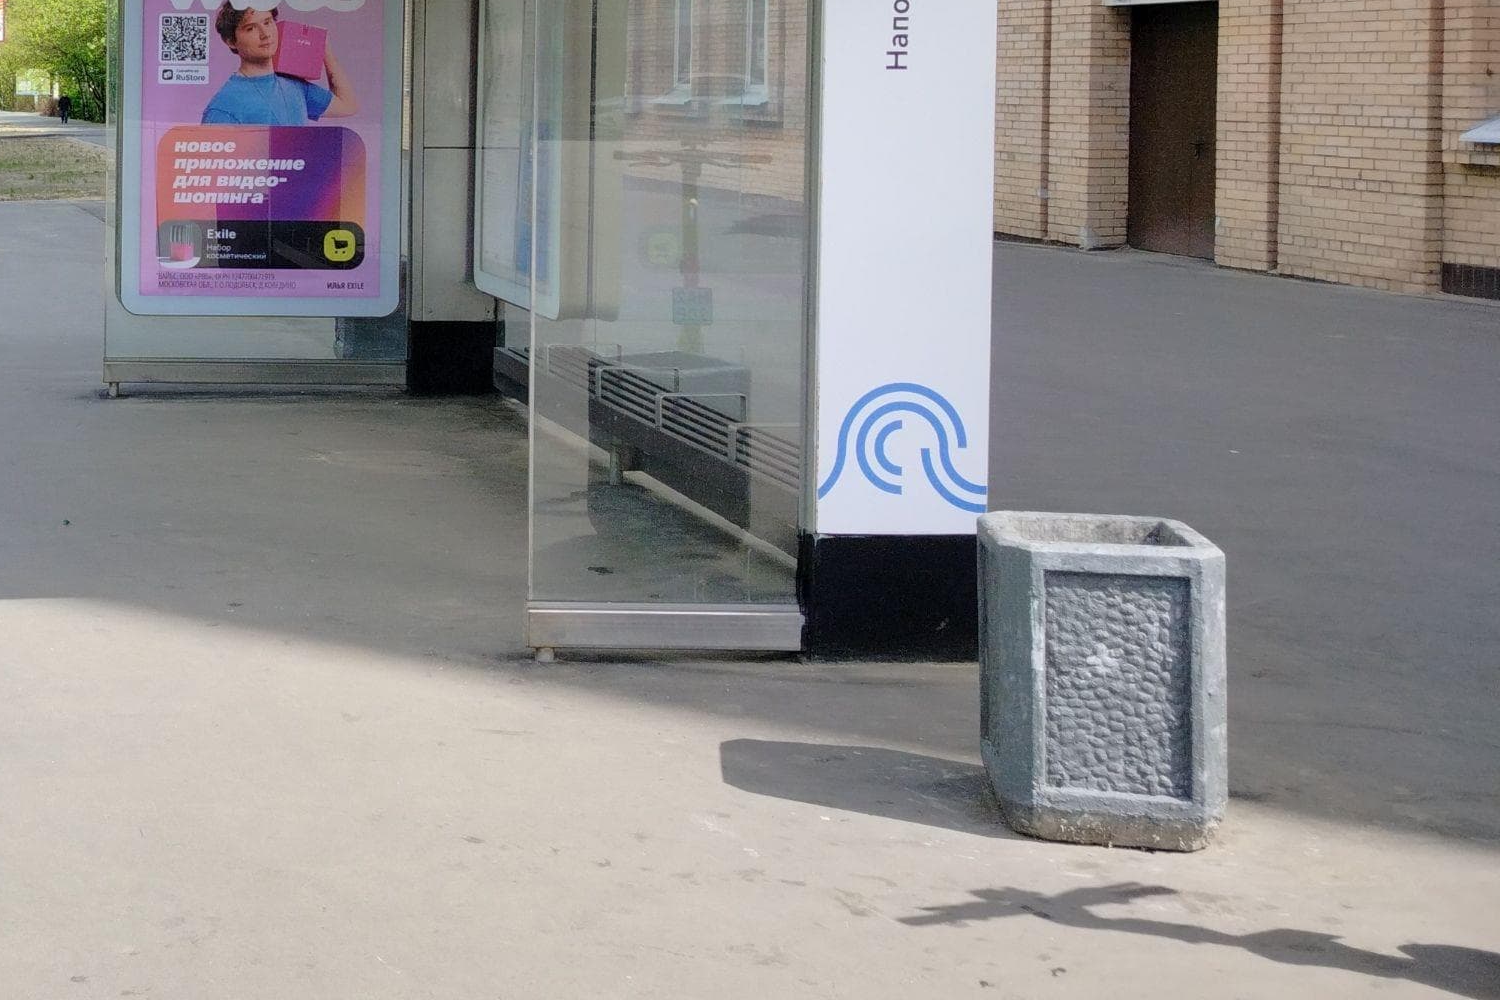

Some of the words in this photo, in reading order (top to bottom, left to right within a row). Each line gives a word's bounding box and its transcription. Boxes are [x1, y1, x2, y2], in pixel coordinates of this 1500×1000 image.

[174, 141, 236, 153] новое
[174, 158, 306, 173] приложение
[173, 175, 212, 188] для
[216, 175, 288, 189] видео-
[173, 192, 264, 204] шопинга
[206, 229, 237, 239] Exile
[206, 244, 232, 252] Набор
[206, 252, 267, 260] косметический
[347, 282, 364, 290] EXILE
